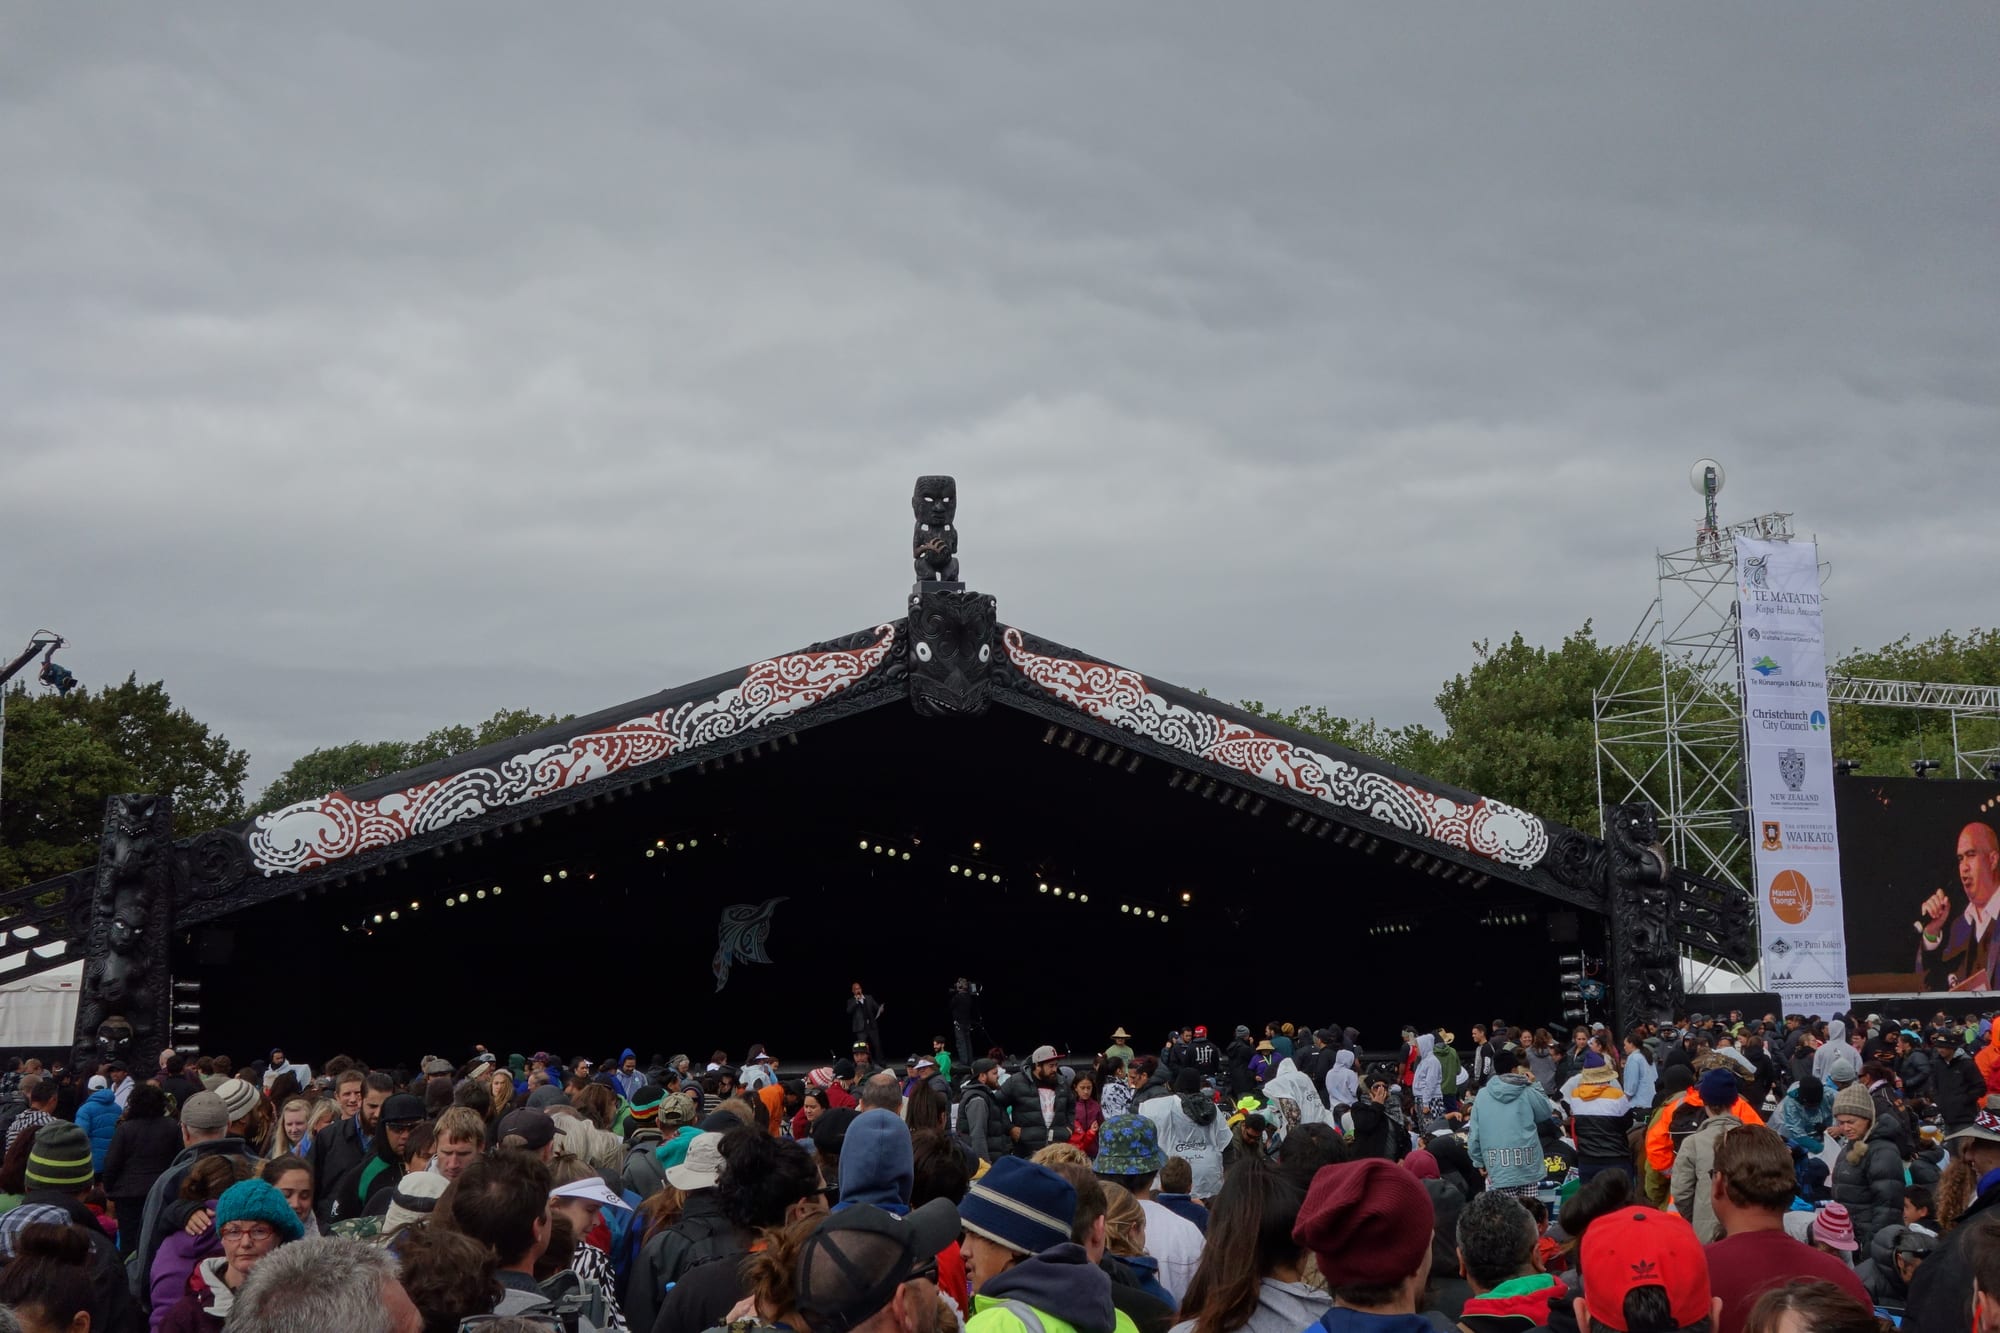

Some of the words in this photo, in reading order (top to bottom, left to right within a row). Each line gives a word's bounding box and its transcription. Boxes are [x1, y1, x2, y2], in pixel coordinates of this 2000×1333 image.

[1753, 590, 1768, 601] TE
[1771, 592, 1819, 605] MATATINI
[1756, 604, 1774, 615] Kapa
[1752, 709, 1808, 720] Christchurch
[1762, 720, 1779, 732] City
[1780, 720, 1809, 731] Council
[1770, 793, 1787, 801] NEW
[1788, 794, 1819, 802] ZEALAND
[1786, 831, 1834, 843] WAIKATO
[1771, 897, 1796, 906] Taonga
[1793, 940, 1803, 949] Te
[1488, 1147, 1535, 1168] FUBU
